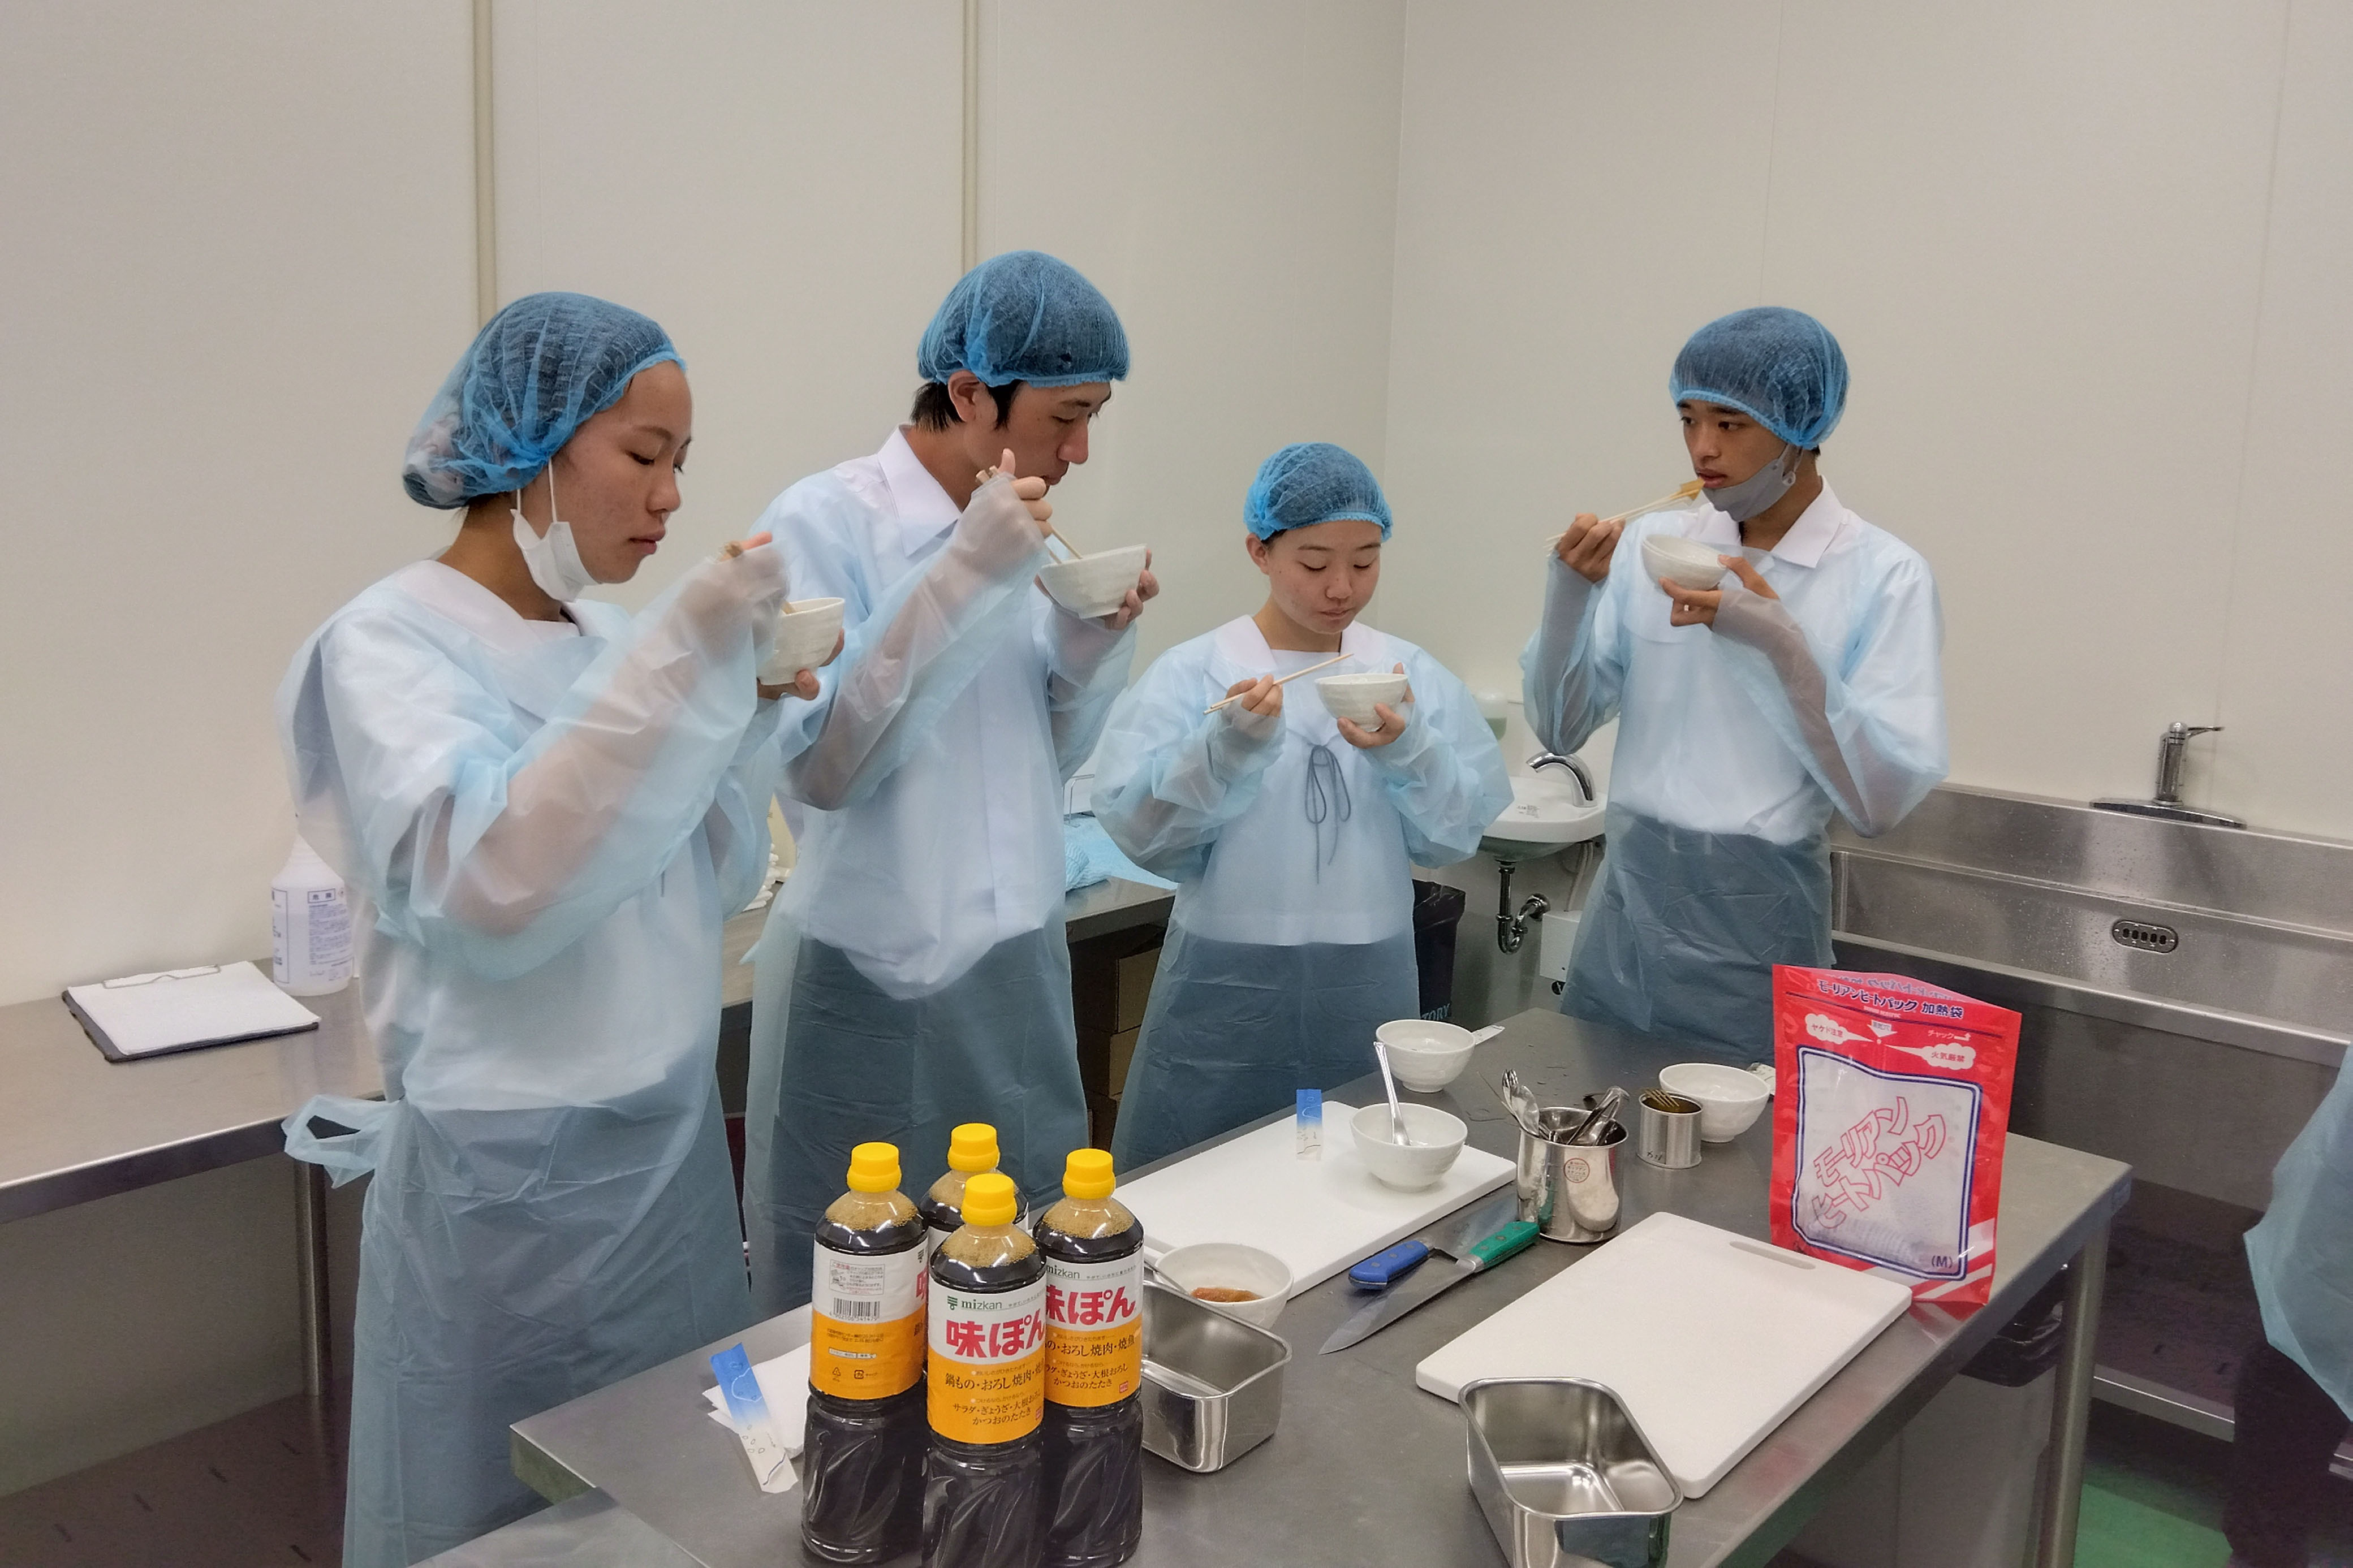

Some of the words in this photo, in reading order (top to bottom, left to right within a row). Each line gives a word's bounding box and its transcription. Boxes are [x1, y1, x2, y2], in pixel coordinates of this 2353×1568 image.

[1922, 1002, 1964, 1019] 加熱袋
[1811, 1023, 1843, 1038] ヤケド注意
[1928, 1029, 1954, 1039] チャック
[1931, 1051, 1965, 1063] 火気厳禁
[1813, 1096, 1909, 1187] モーリアン
[1811, 1114, 1946, 1229] ヒートパック
[1931, 1255, 1953, 1269] (M)
[1046, 1264, 1080, 1279] mizkan
[962, 1299, 1002, 1310] mizkan
[946, 1308, 1045, 1358] 味ぽん
[1045, 1334, 1135, 1357] の・おろし焼肉・焼魚
[1054, 1377, 1113, 1389] かつおのたたき
[973, 1407, 1031, 1426] かつおのたたき
